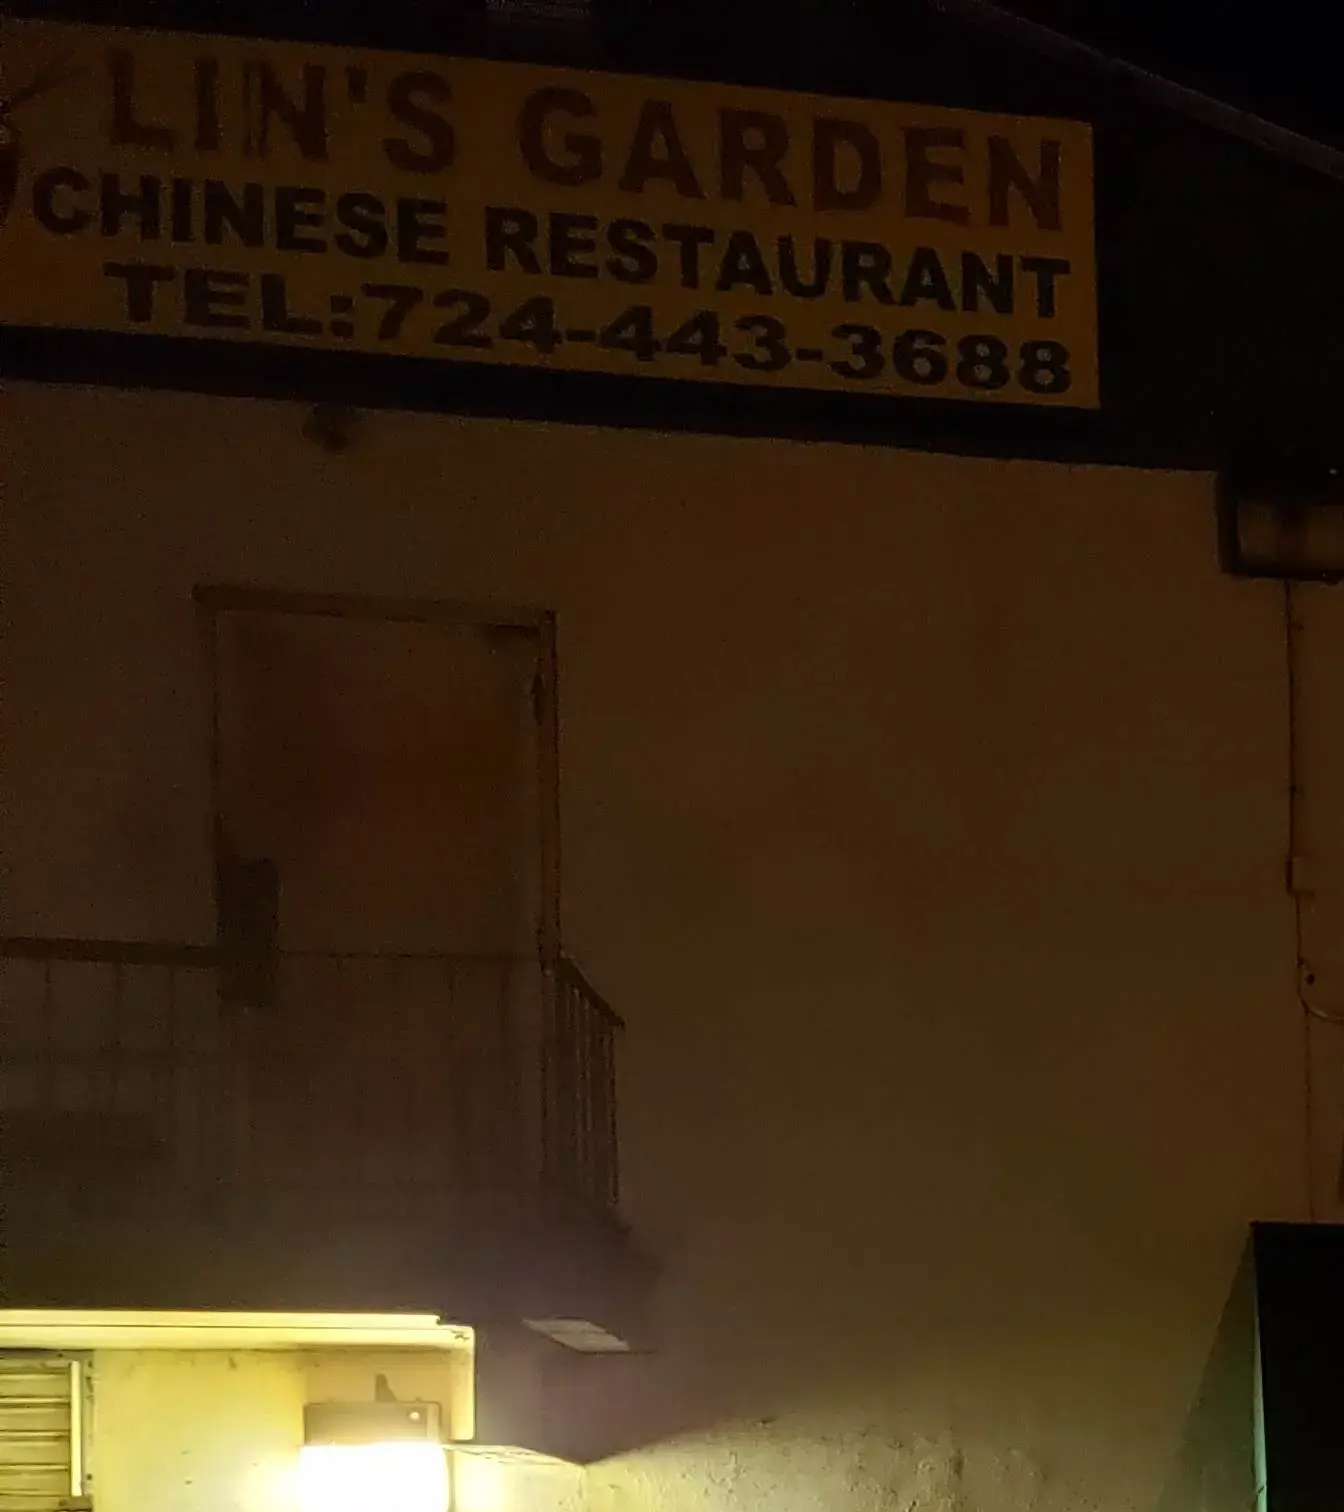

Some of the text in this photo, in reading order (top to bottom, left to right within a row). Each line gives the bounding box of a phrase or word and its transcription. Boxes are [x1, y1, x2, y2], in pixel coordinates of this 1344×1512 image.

[105, 52, 1063, 231] LIN'S GARDEN
[31, 167, 1070, 320] CHINESE RESTAURANT
